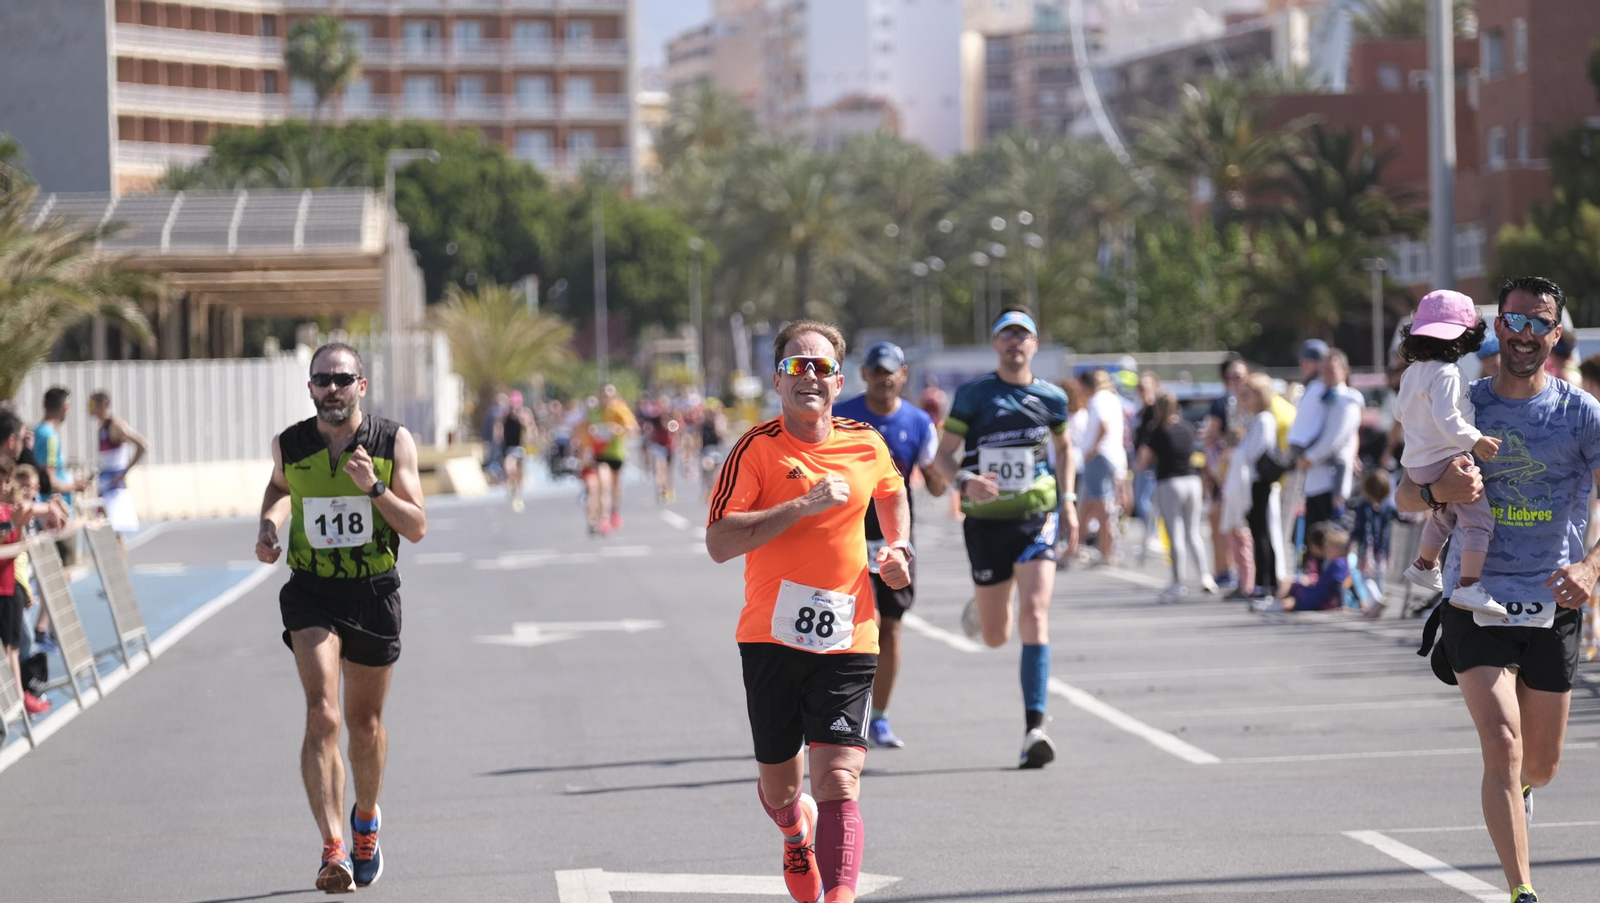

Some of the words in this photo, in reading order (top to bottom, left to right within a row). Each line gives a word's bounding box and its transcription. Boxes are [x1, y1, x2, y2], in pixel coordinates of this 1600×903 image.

[989, 463, 1025, 479] 503
[1490, 506, 1504, 519] as
[315, 512, 364, 536] 118
[795, 606, 835, 638] 88
[830, 723, 851, 732] adidas
